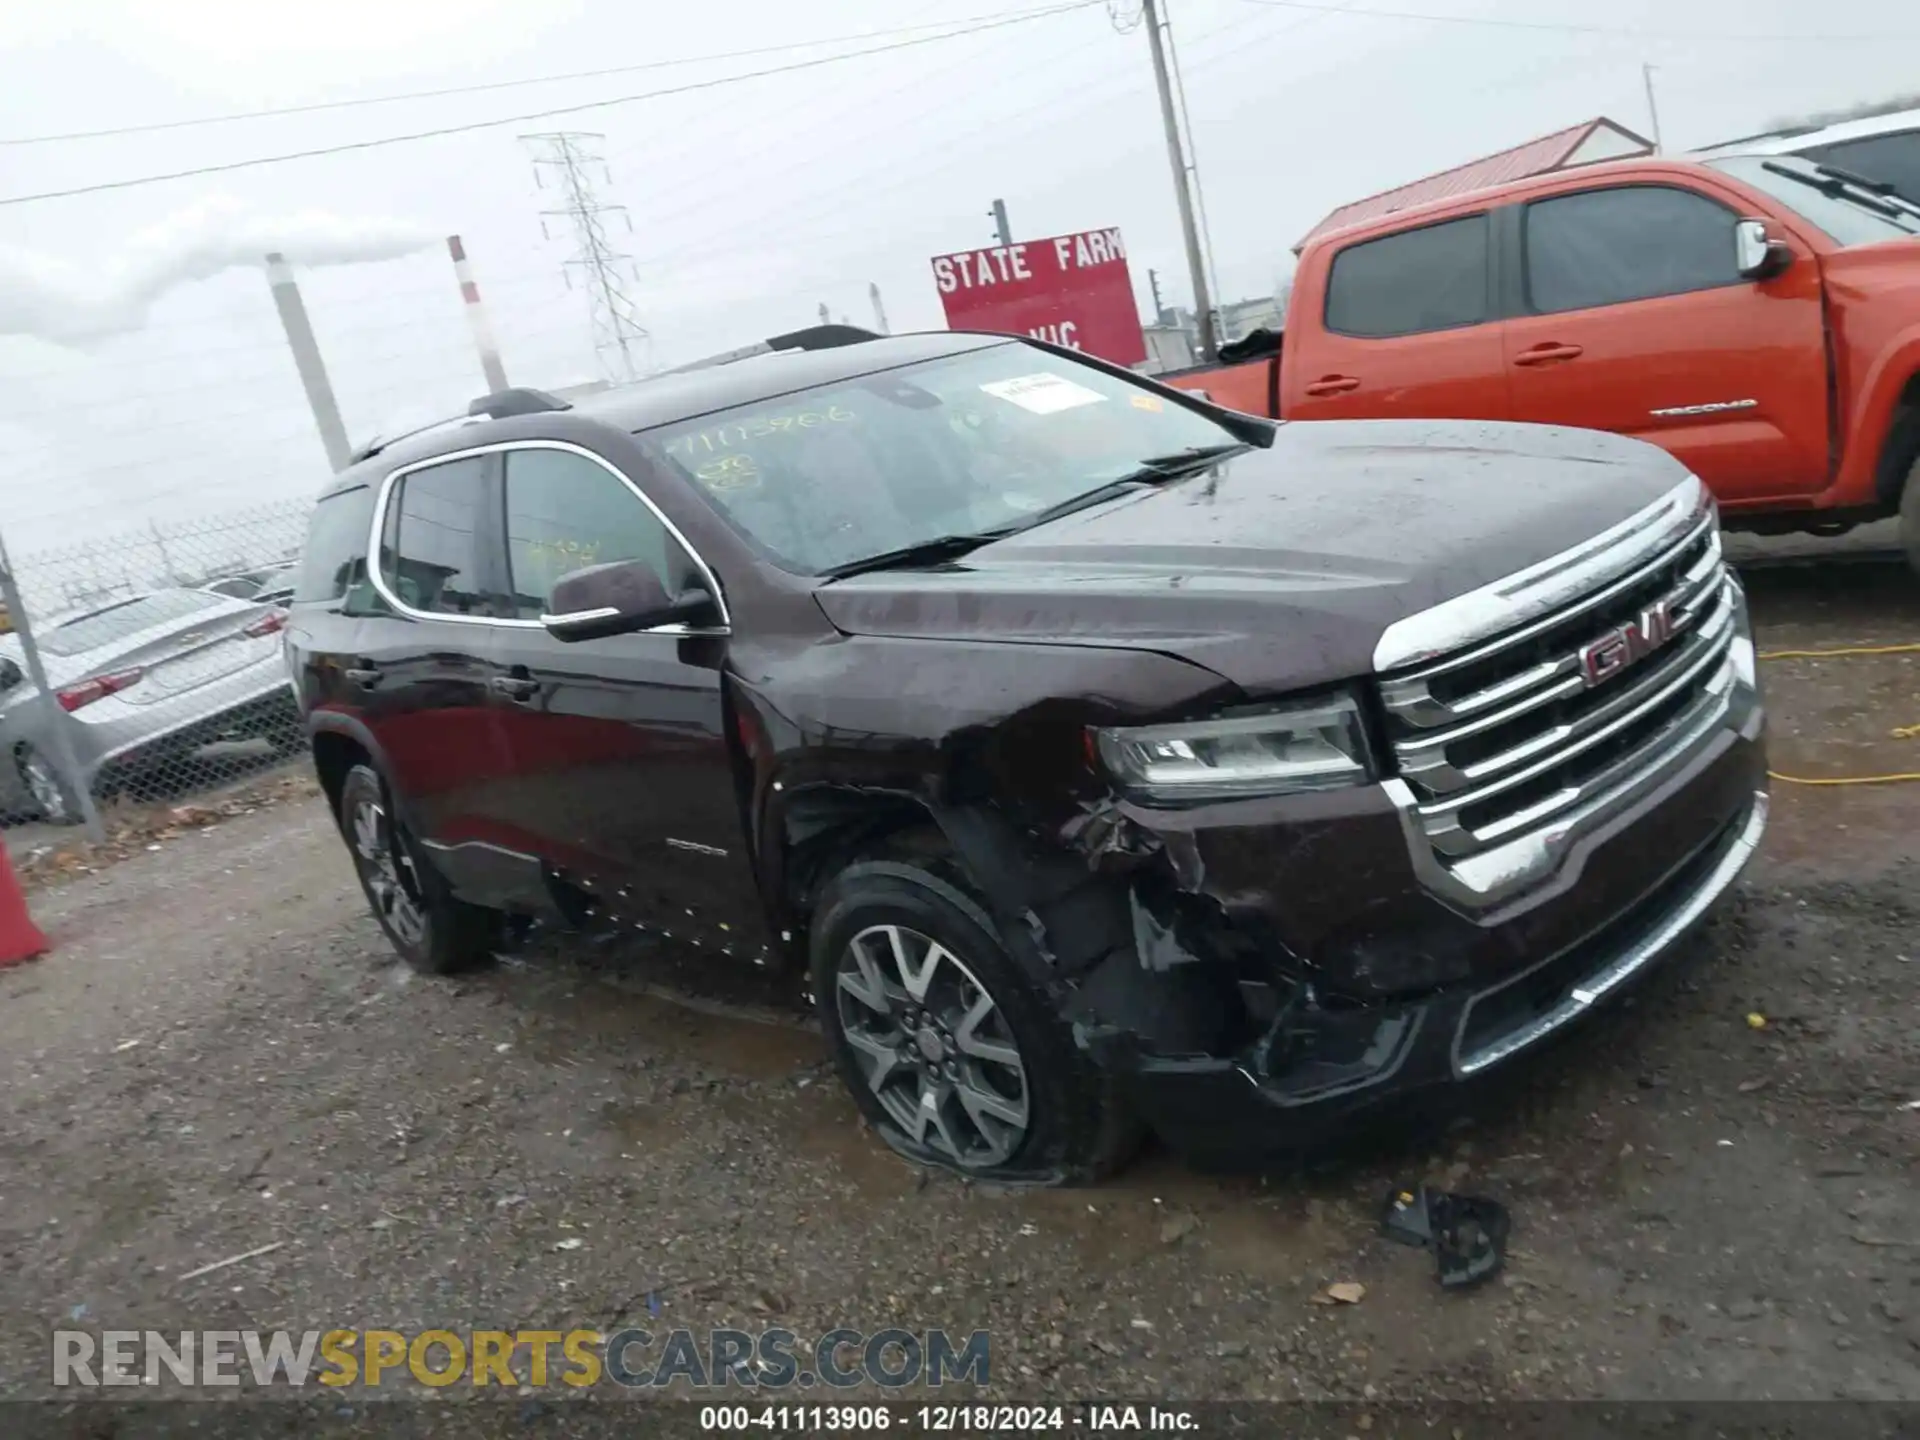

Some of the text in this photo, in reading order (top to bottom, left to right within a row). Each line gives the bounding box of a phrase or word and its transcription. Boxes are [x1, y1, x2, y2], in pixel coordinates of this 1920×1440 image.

[934, 229, 1125, 293] STATE FARM
[1579, 586, 1692, 689] GMC
